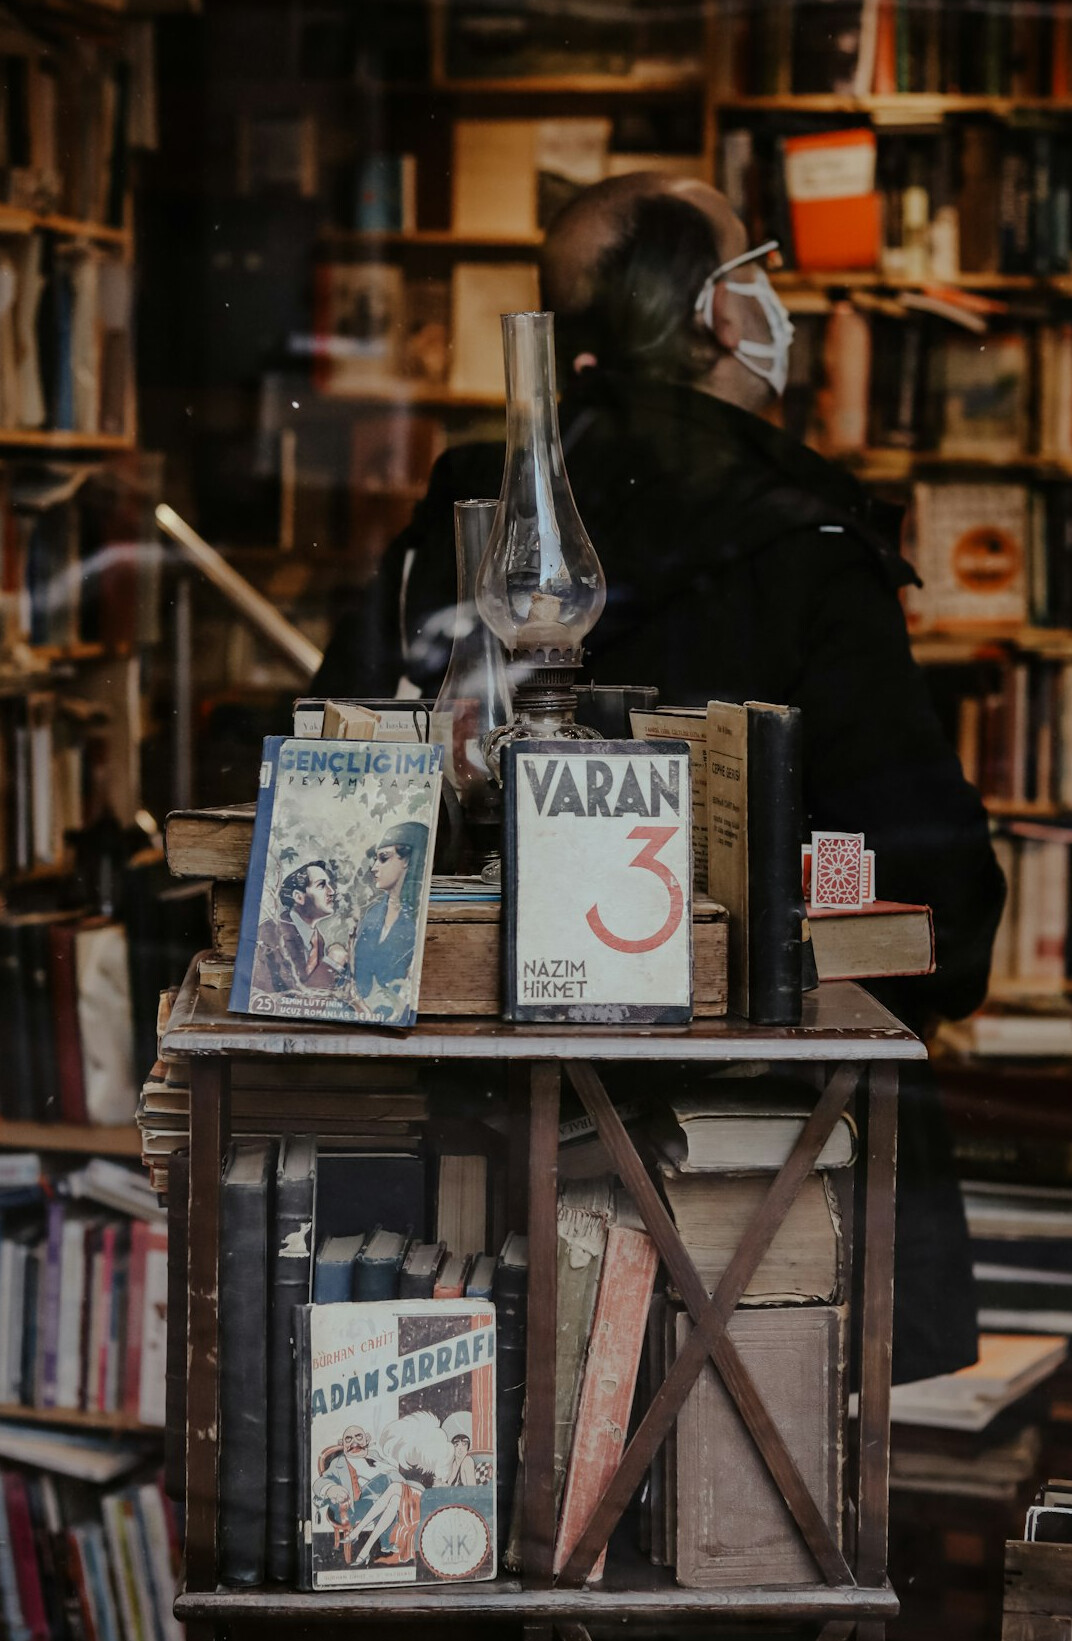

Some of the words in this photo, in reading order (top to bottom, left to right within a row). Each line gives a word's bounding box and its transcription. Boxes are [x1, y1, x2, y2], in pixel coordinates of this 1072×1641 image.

[378, 778, 431, 789] SAFA
[523, 760, 680, 817] VARAN
[586, 826, 684, 954] 3
[523, 959, 586, 978] NAZIM
[256, 998, 272, 1011] 25
[304, 1008, 351, 1019] ROMANLAR
[360, 1329, 395, 1354] CAHİT
[385, 1330, 494, 1394] SARRAFI
